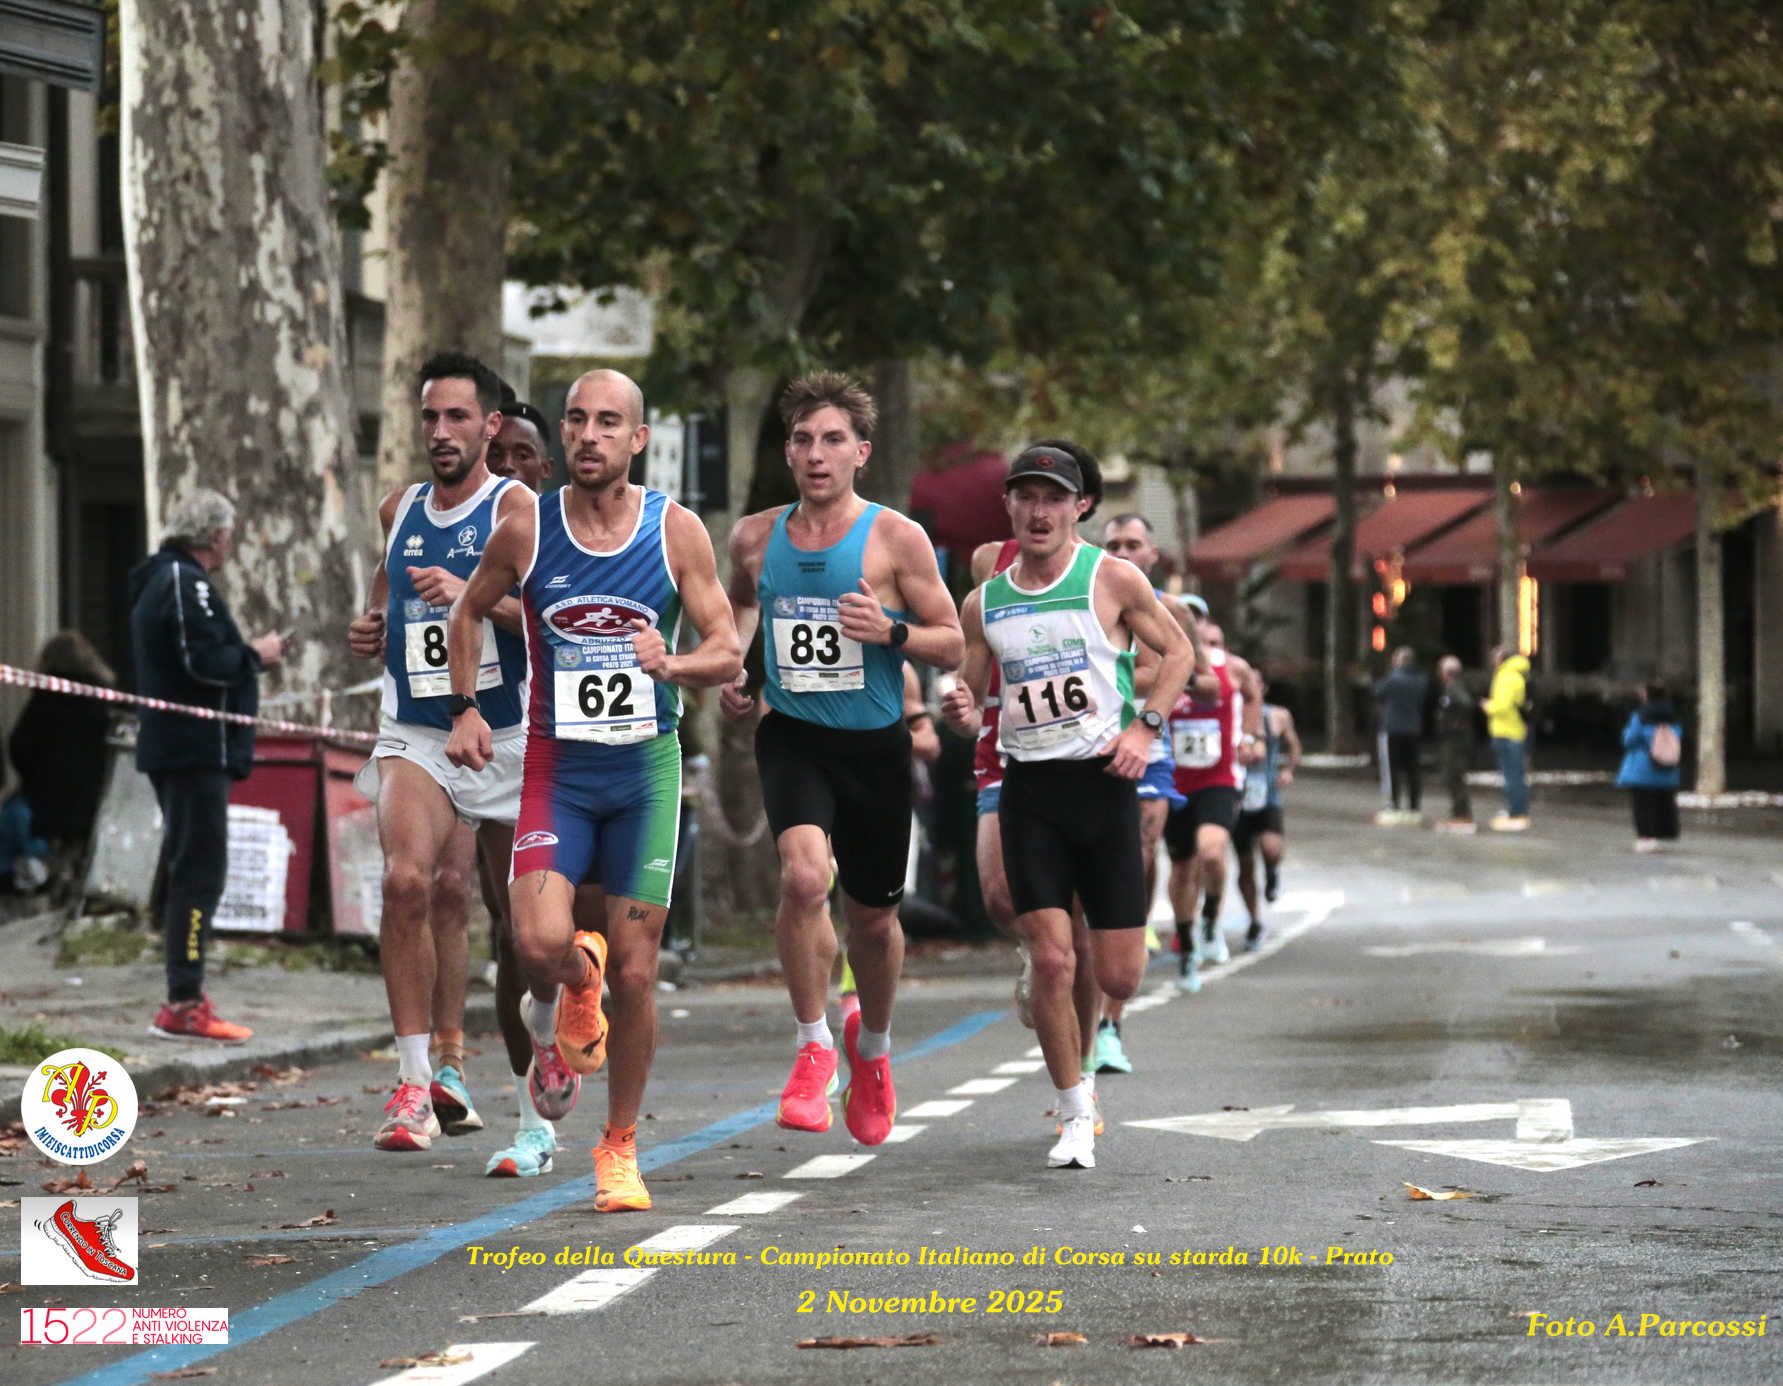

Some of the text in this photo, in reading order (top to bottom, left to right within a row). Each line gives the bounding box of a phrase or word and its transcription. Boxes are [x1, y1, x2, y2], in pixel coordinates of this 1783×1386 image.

[577, 596, 614, 604] ATLETICA
[615, 598, 649, 613] VOMANO
[582, 644, 623, 655] CAMPIONATO
[790, 624, 841, 665] 83
[578, 673, 634, 718] 62
[1018, 676, 1088, 723] 116
